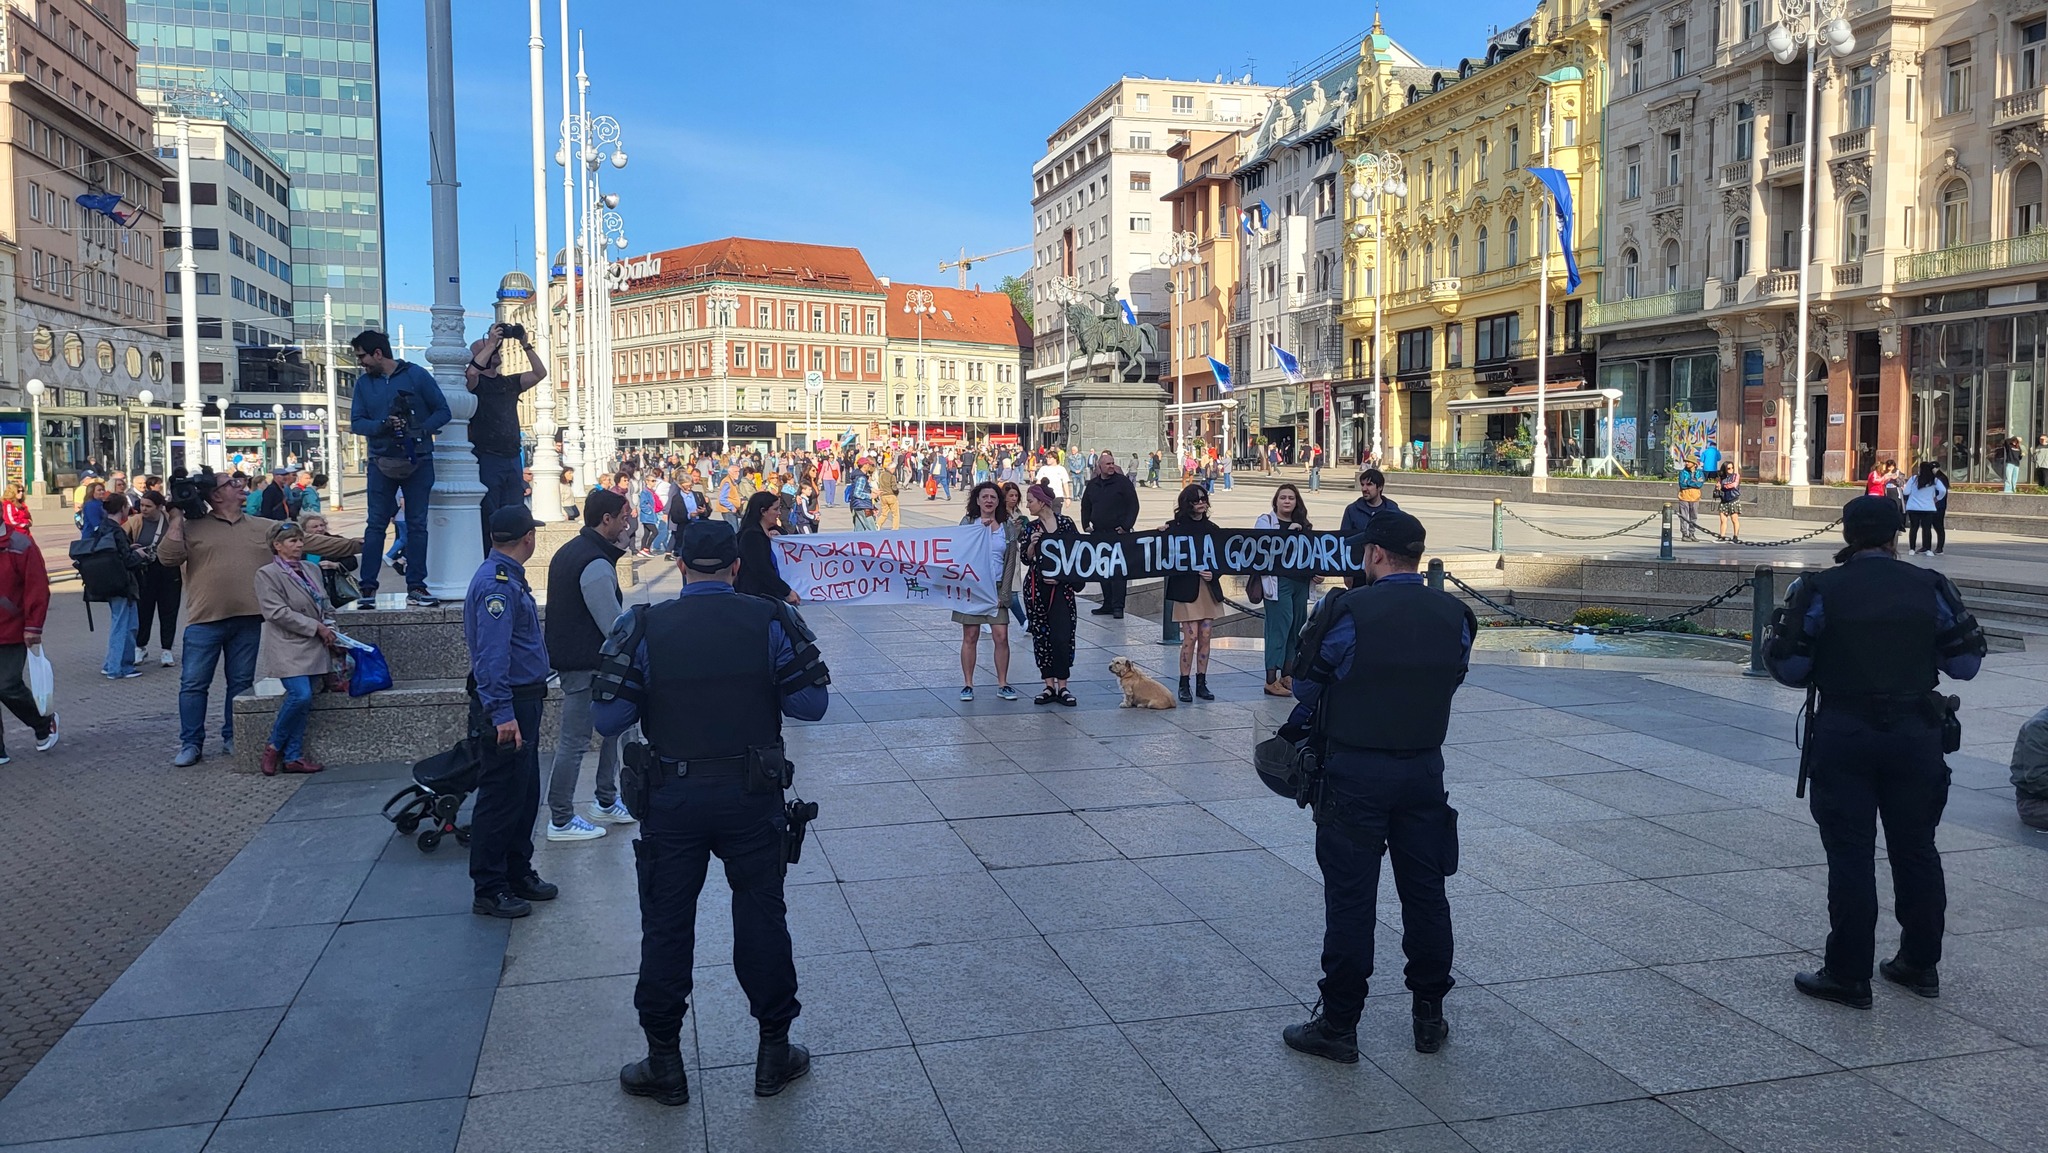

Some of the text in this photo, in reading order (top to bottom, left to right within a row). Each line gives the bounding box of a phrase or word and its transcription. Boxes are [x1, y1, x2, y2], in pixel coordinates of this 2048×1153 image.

[240, 410, 260, 419] Kad
[263, 410, 287, 419] znš
[289, 410, 318, 420] bolje,
[778, 538, 954, 566] RASKIDANJE
[1040, 533, 1366, 579] SVOGA TIJELA GOSPODARIC
[810, 559, 980, 582] UGOVORA SA
[810, 577, 890, 602] SVETOM
